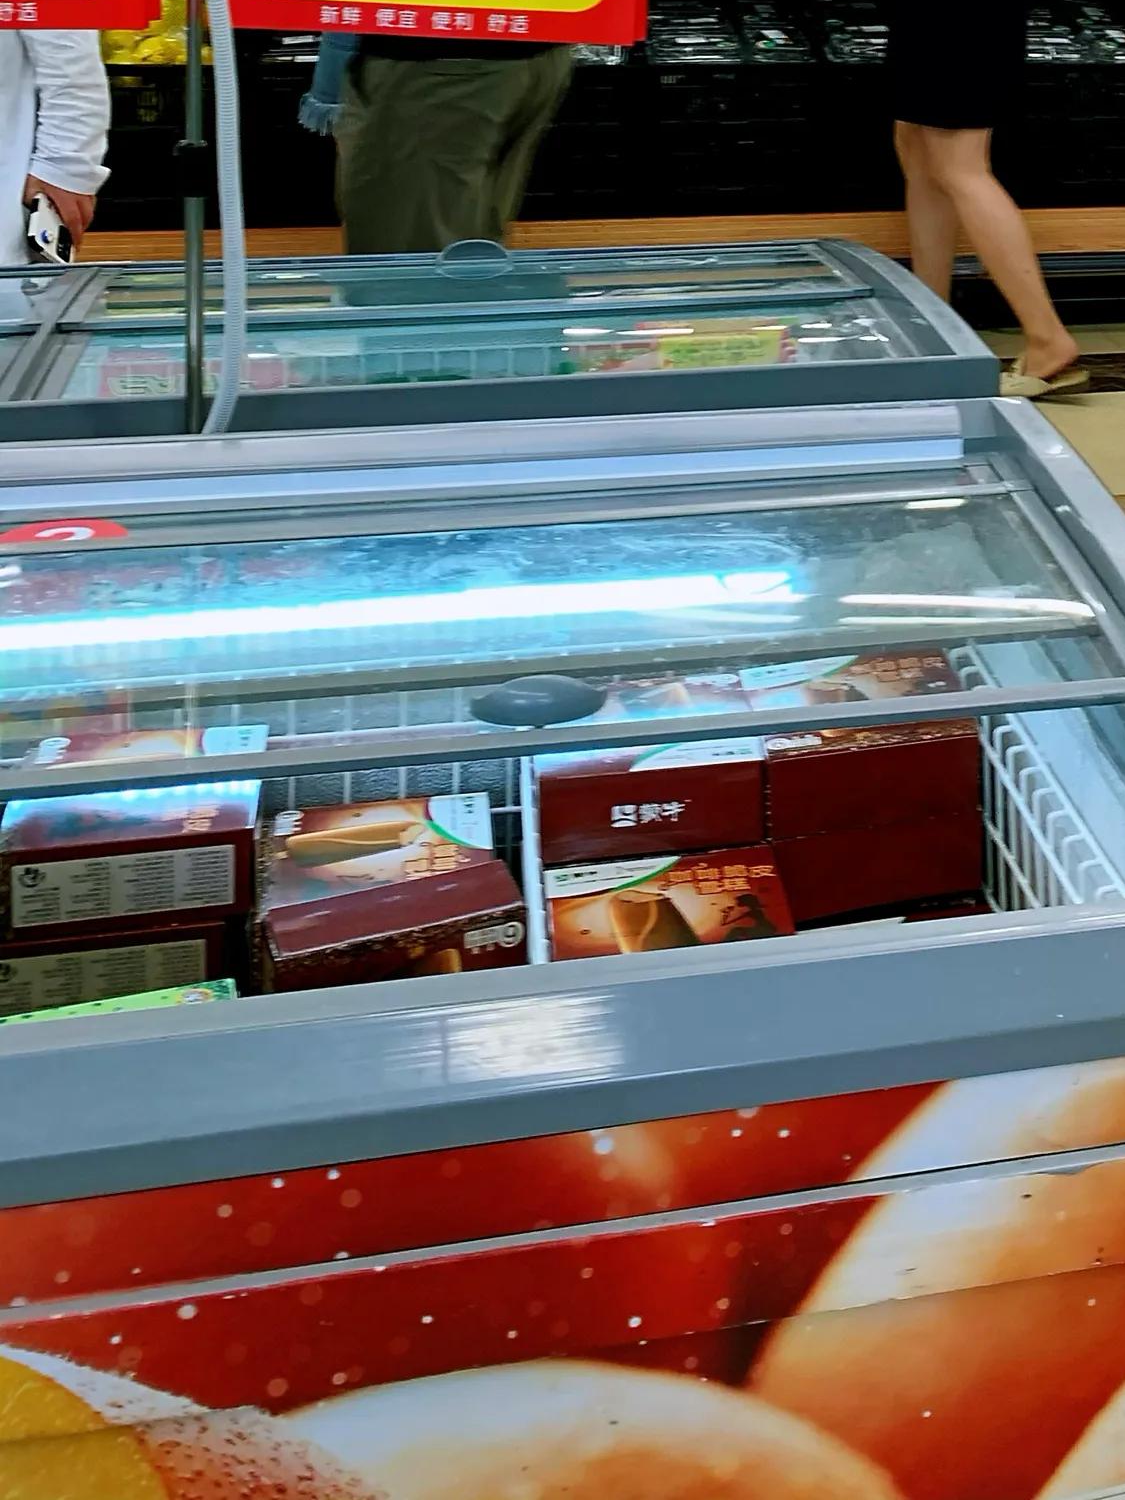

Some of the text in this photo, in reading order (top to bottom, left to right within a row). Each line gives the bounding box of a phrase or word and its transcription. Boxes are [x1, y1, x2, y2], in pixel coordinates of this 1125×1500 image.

[319, 5, 362, 25] 新鲜
[375, 8, 419, 29] 便宜
[431, 11, 474, 31] 便利
